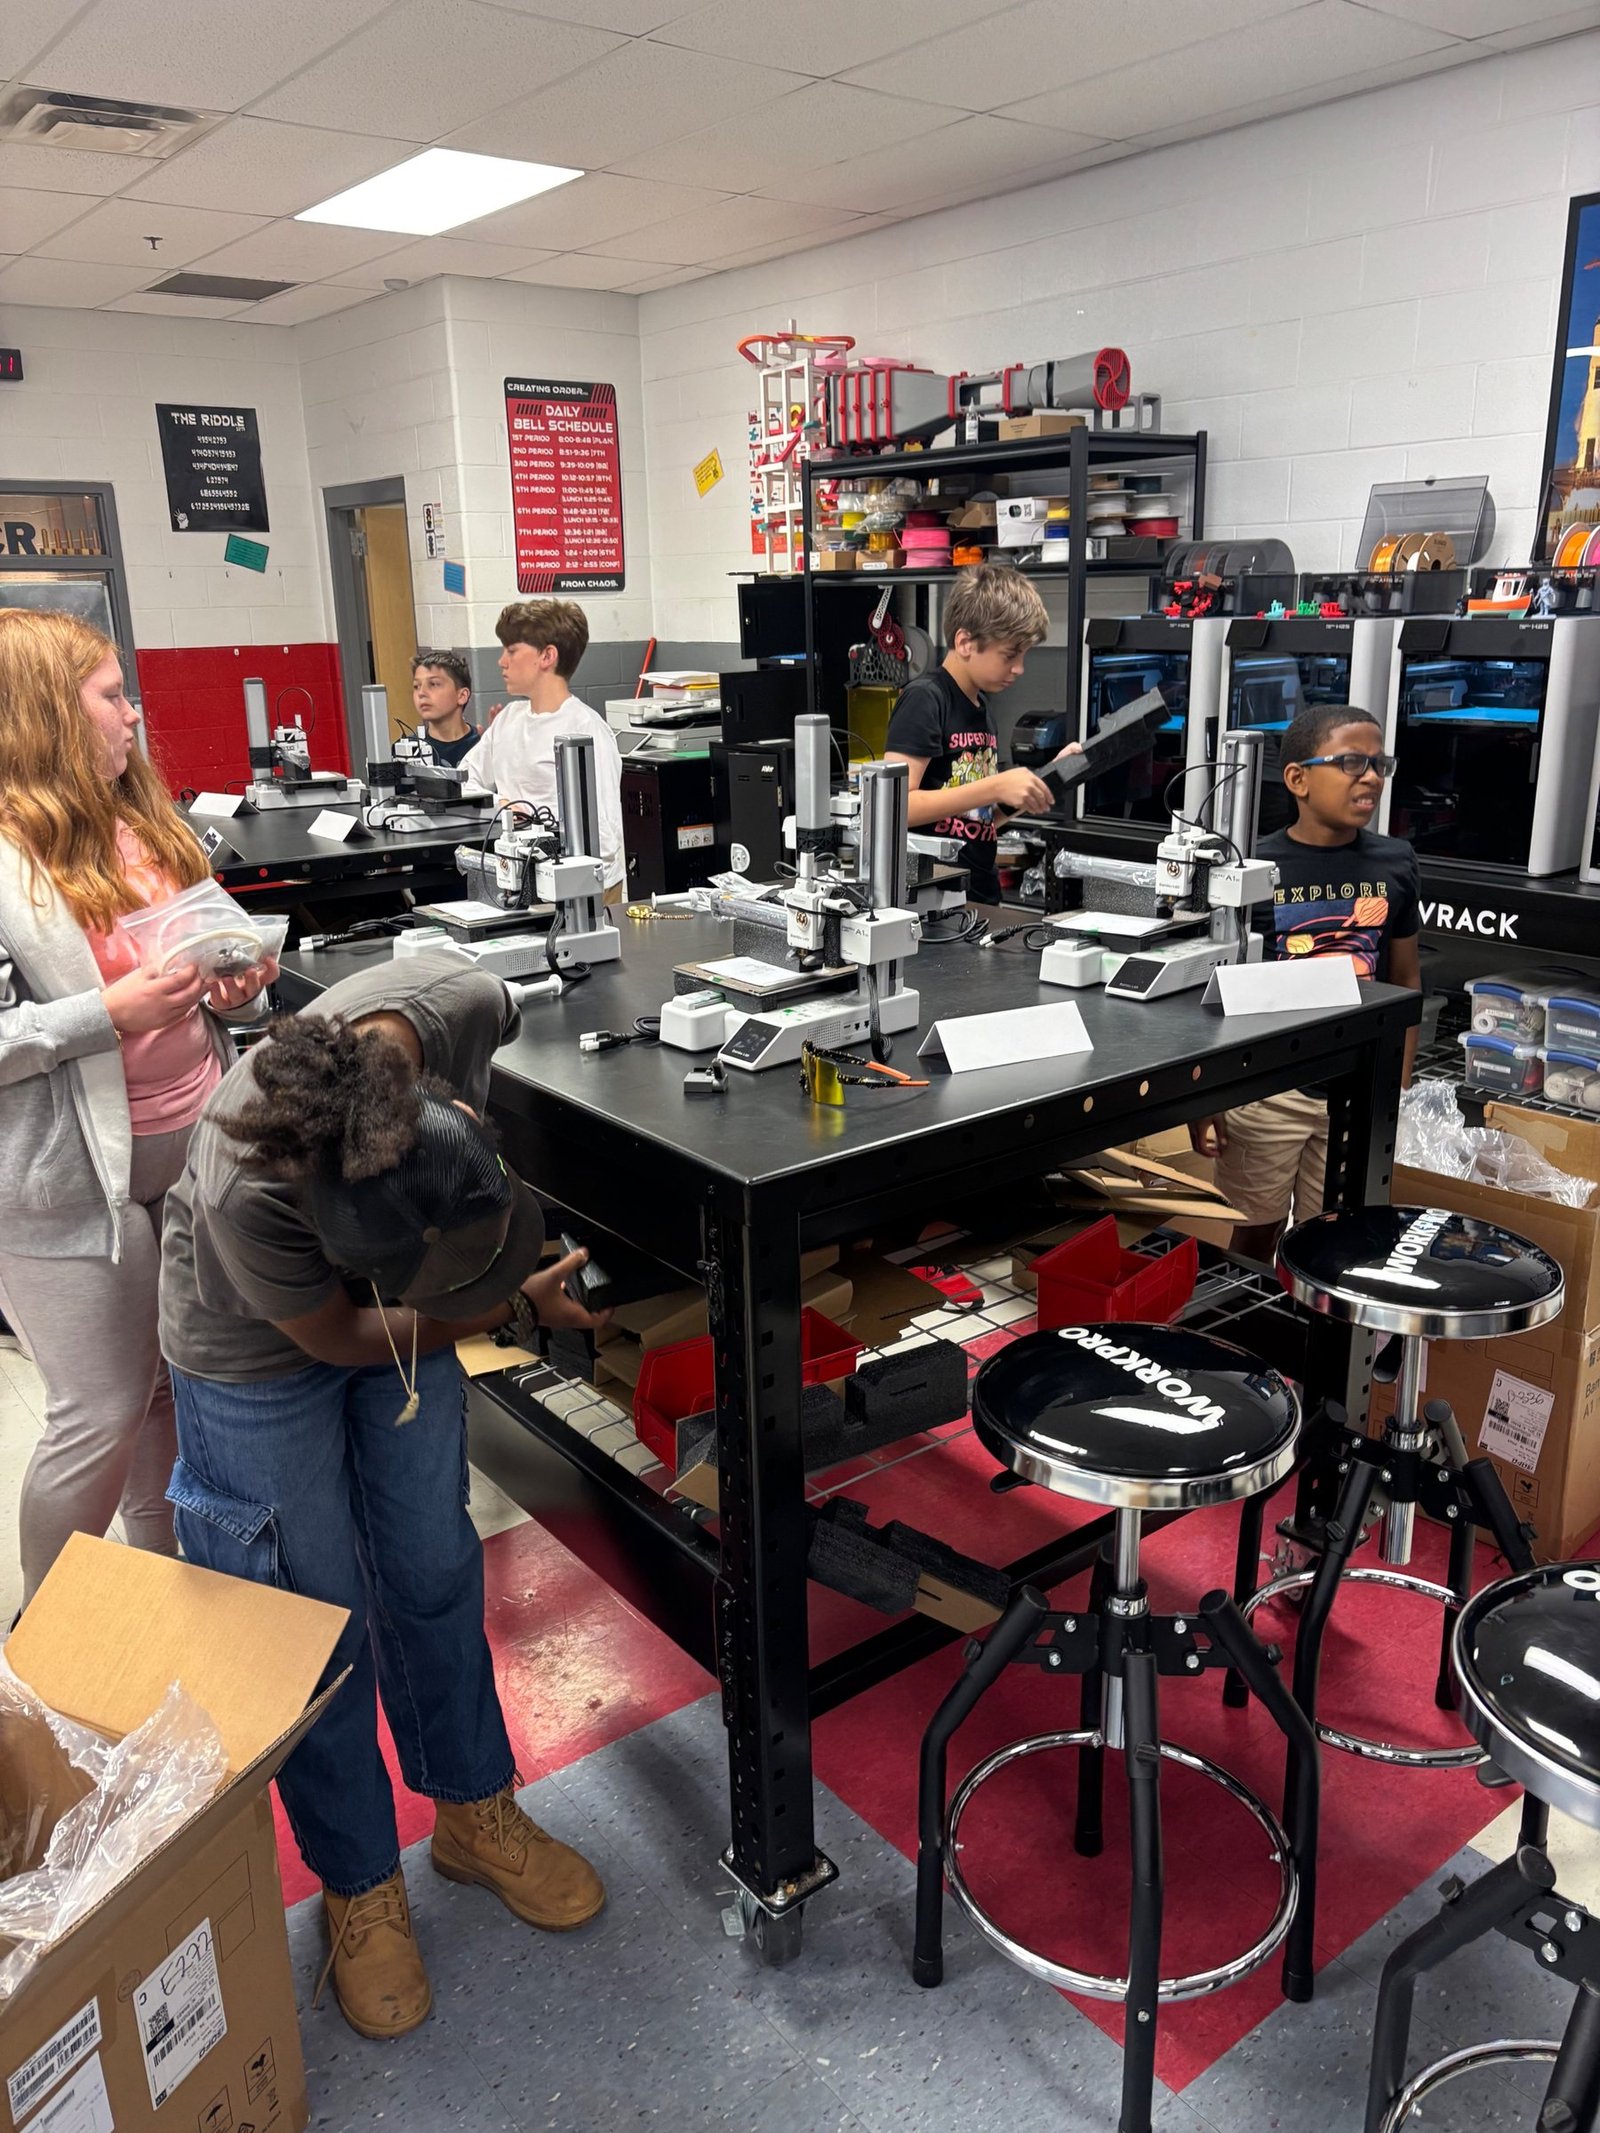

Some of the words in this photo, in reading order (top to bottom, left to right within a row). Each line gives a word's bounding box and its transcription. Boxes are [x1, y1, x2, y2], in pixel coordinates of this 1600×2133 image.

[507, 383, 551, 394] CREATING
[546, 404, 580, 418] DAILY
[170, 412, 197, 425] THE
[514, 418, 545, 430] BELL
[548, 420, 614, 433] SCHEDULE
[524, 434, 550, 442] PERIOD
[528, 447, 553, 455] PERIOD
[949, 732, 985, 748] SUPER
[1274, 882, 1388, 905] EXPLORE
[1382, 1208, 1452, 1274] WORKPRO
[1058, 1327, 1226, 1425] WORKPRO
